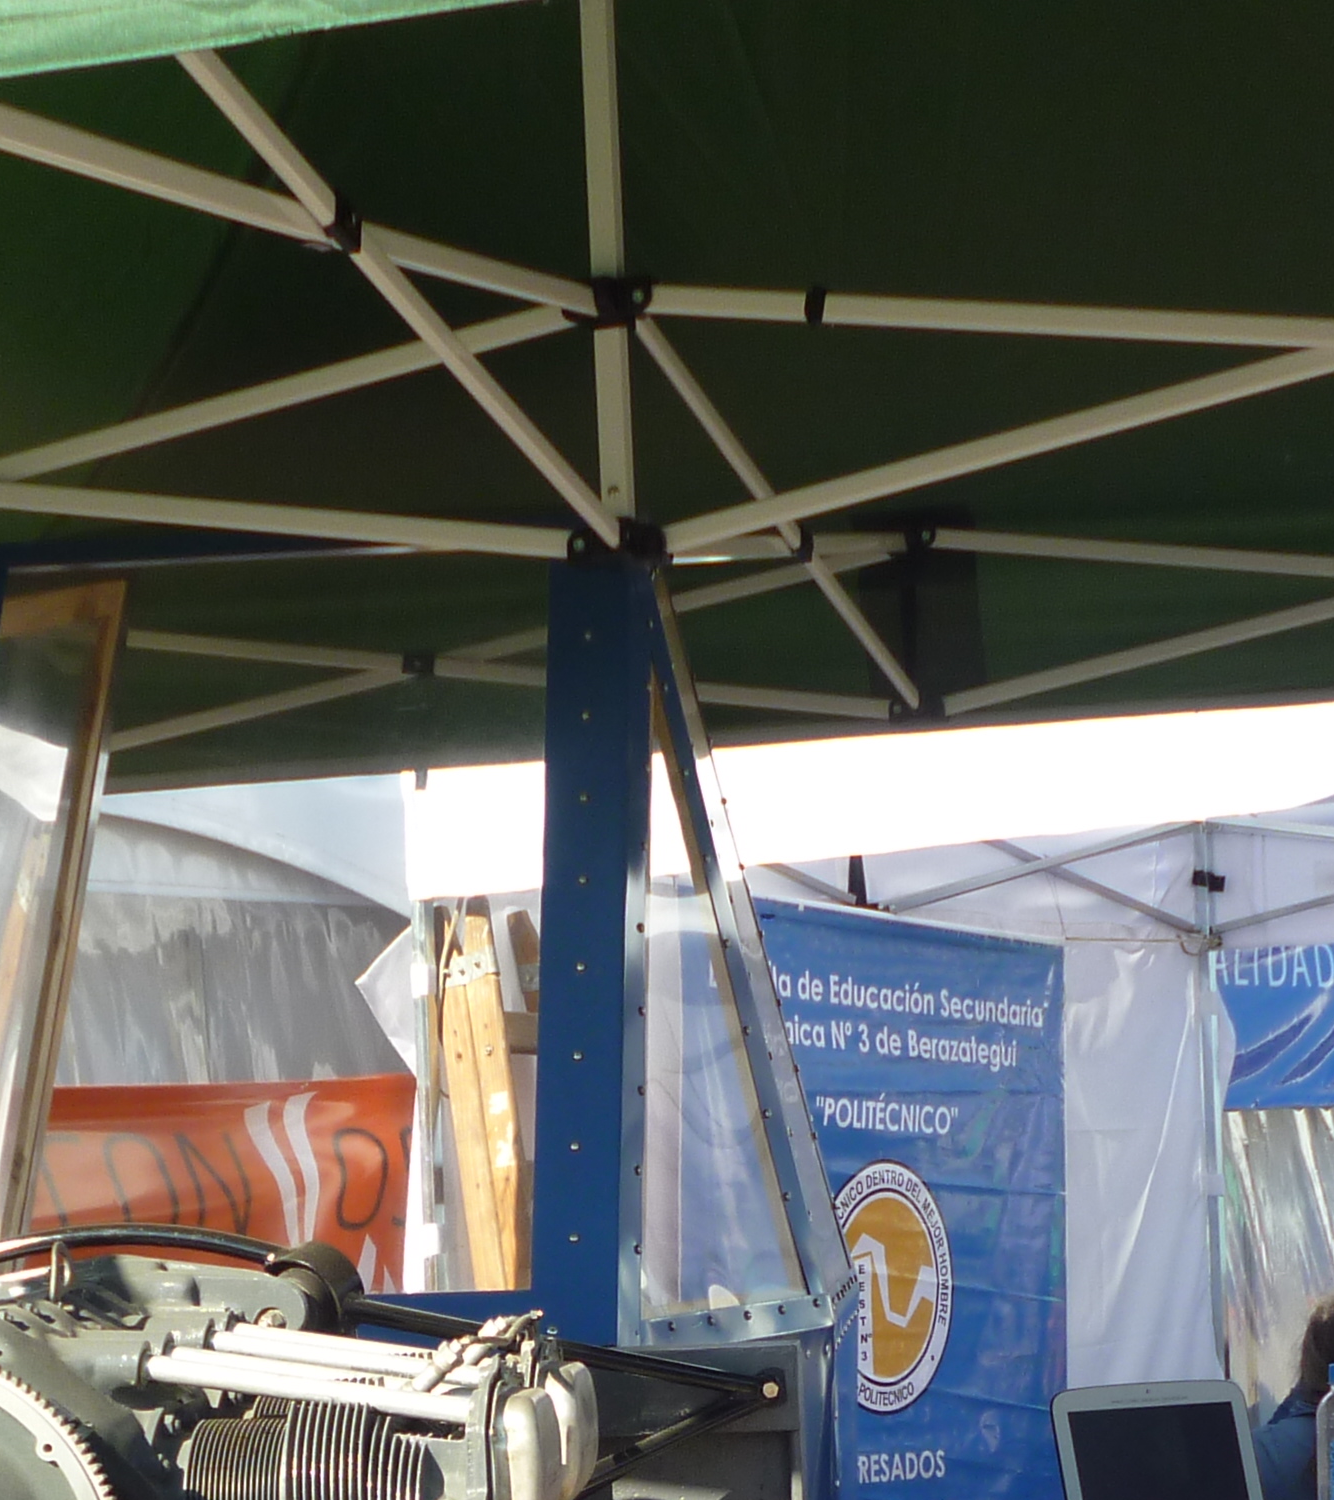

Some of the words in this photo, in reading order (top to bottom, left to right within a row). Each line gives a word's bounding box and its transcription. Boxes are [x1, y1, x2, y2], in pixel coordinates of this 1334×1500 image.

[797, 970, 824, 1001] de
[829, 974, 935, 1016] Educación
[940, 988, 1044, 1028] Secundaria
[785, 1014, 826, 1048] nica
[858, 1024, 870, 1053] 3
[875, 1026, 902, 1056] de
[907, 1029, 1017, 1072] Berazategui
[865, 1169, 905, 1190] DENTRO
[905, 1178, 922, 1203] DEL
[921, 1197, 945, 1250] MEJOR
[938, 1252, 950, 1327] HOMBRE
[857, 1449, 946, 1484] RESADOS
